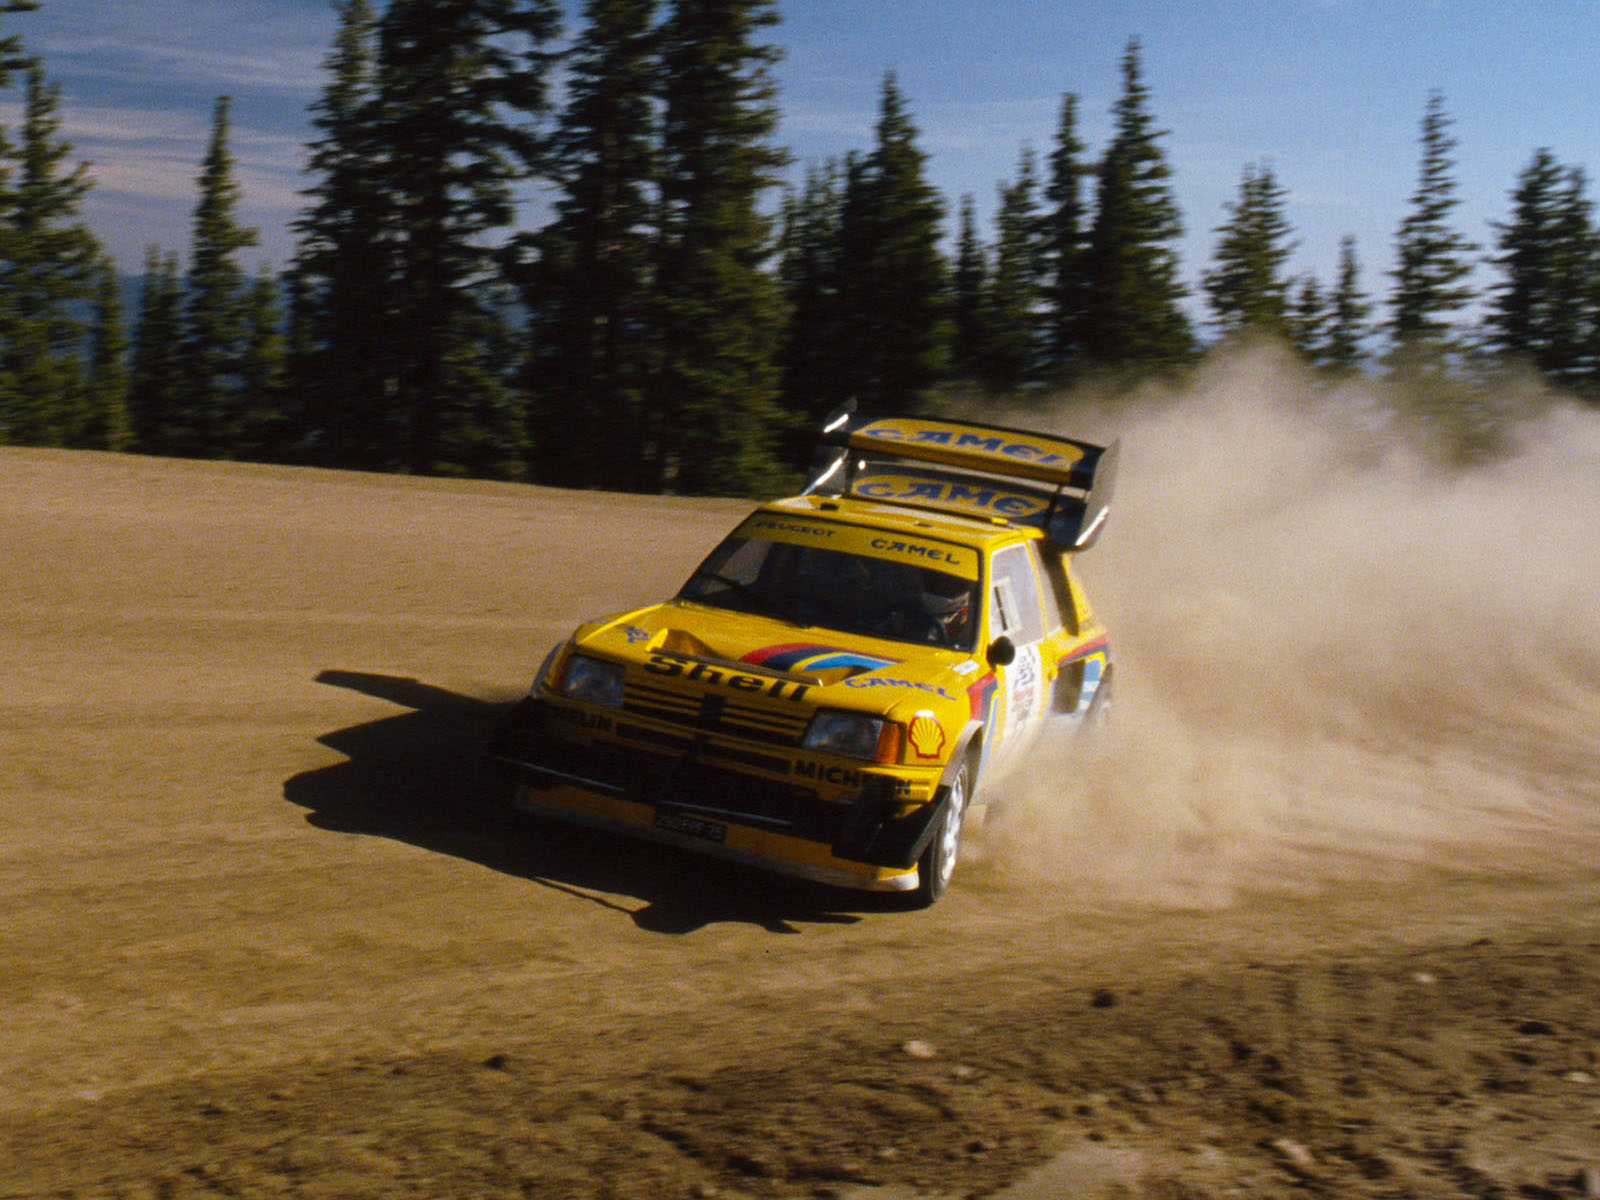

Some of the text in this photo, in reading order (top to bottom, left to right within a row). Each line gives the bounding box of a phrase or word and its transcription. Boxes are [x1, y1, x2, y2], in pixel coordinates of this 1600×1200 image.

[863, 426, 1065, 467] CAMEL
[855, 482, 1038, 516] CAME
[871, 538, 961, 566] CAMEL
[643, 655, 811, 701] Shell
[844, 677, 957, 701] CAMEL
